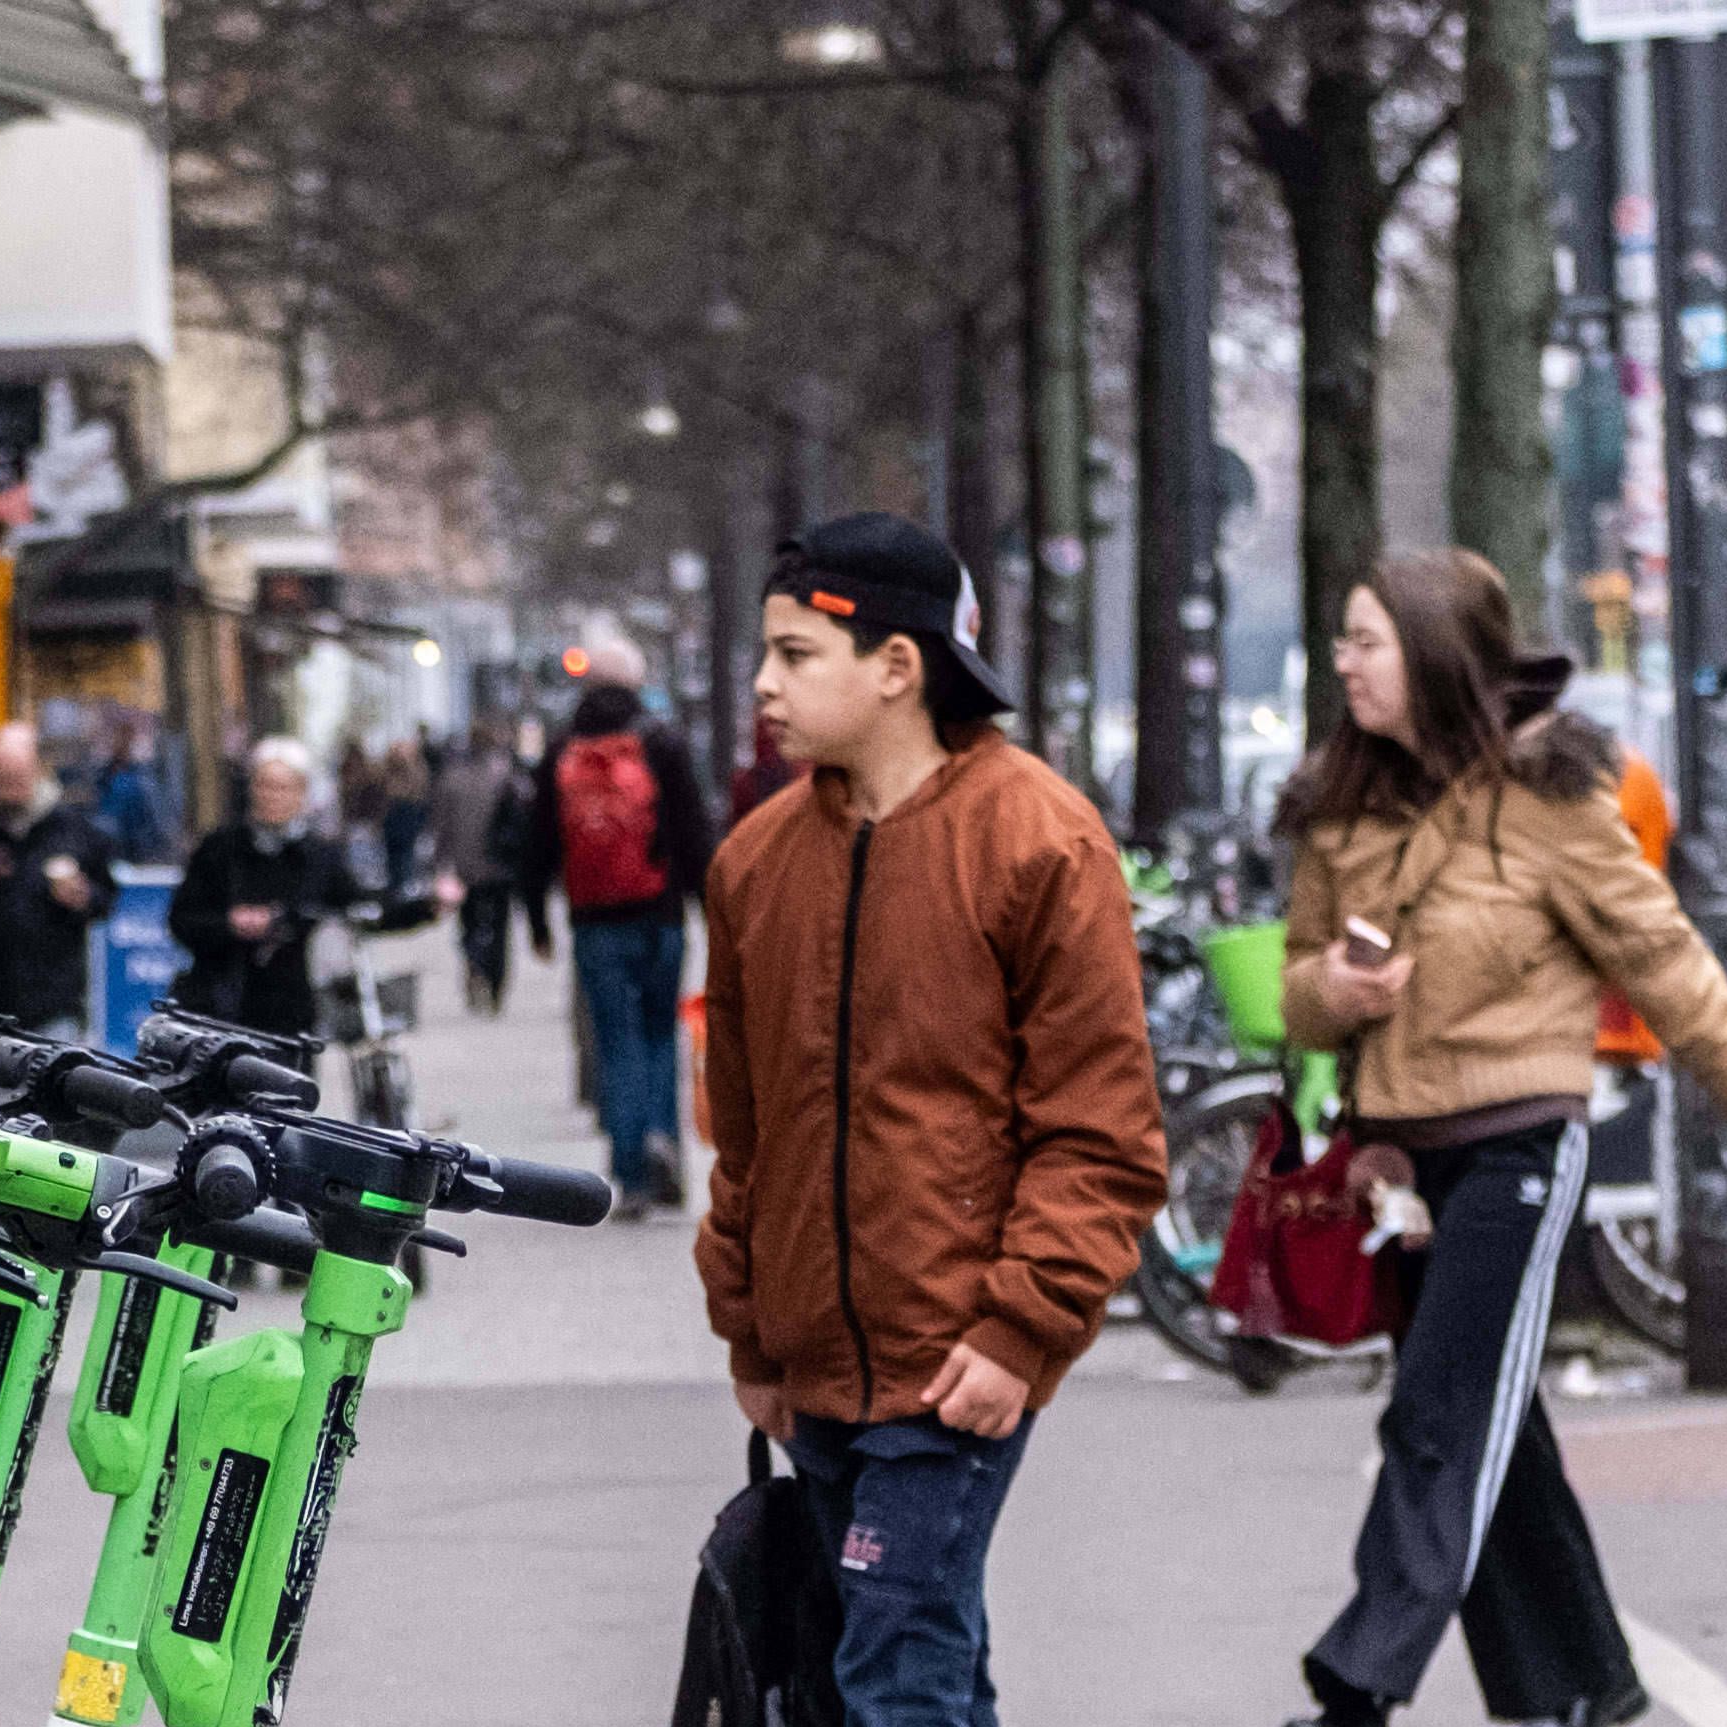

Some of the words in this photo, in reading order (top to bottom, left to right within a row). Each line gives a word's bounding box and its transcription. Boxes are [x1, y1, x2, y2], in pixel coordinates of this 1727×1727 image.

[212, 1458, 234, 1506] 77044733
[209, 1506, 220, 1520] 69
[204, 1520, 216, 1539] +49
[179, 1602, 193, 1627] Lime
